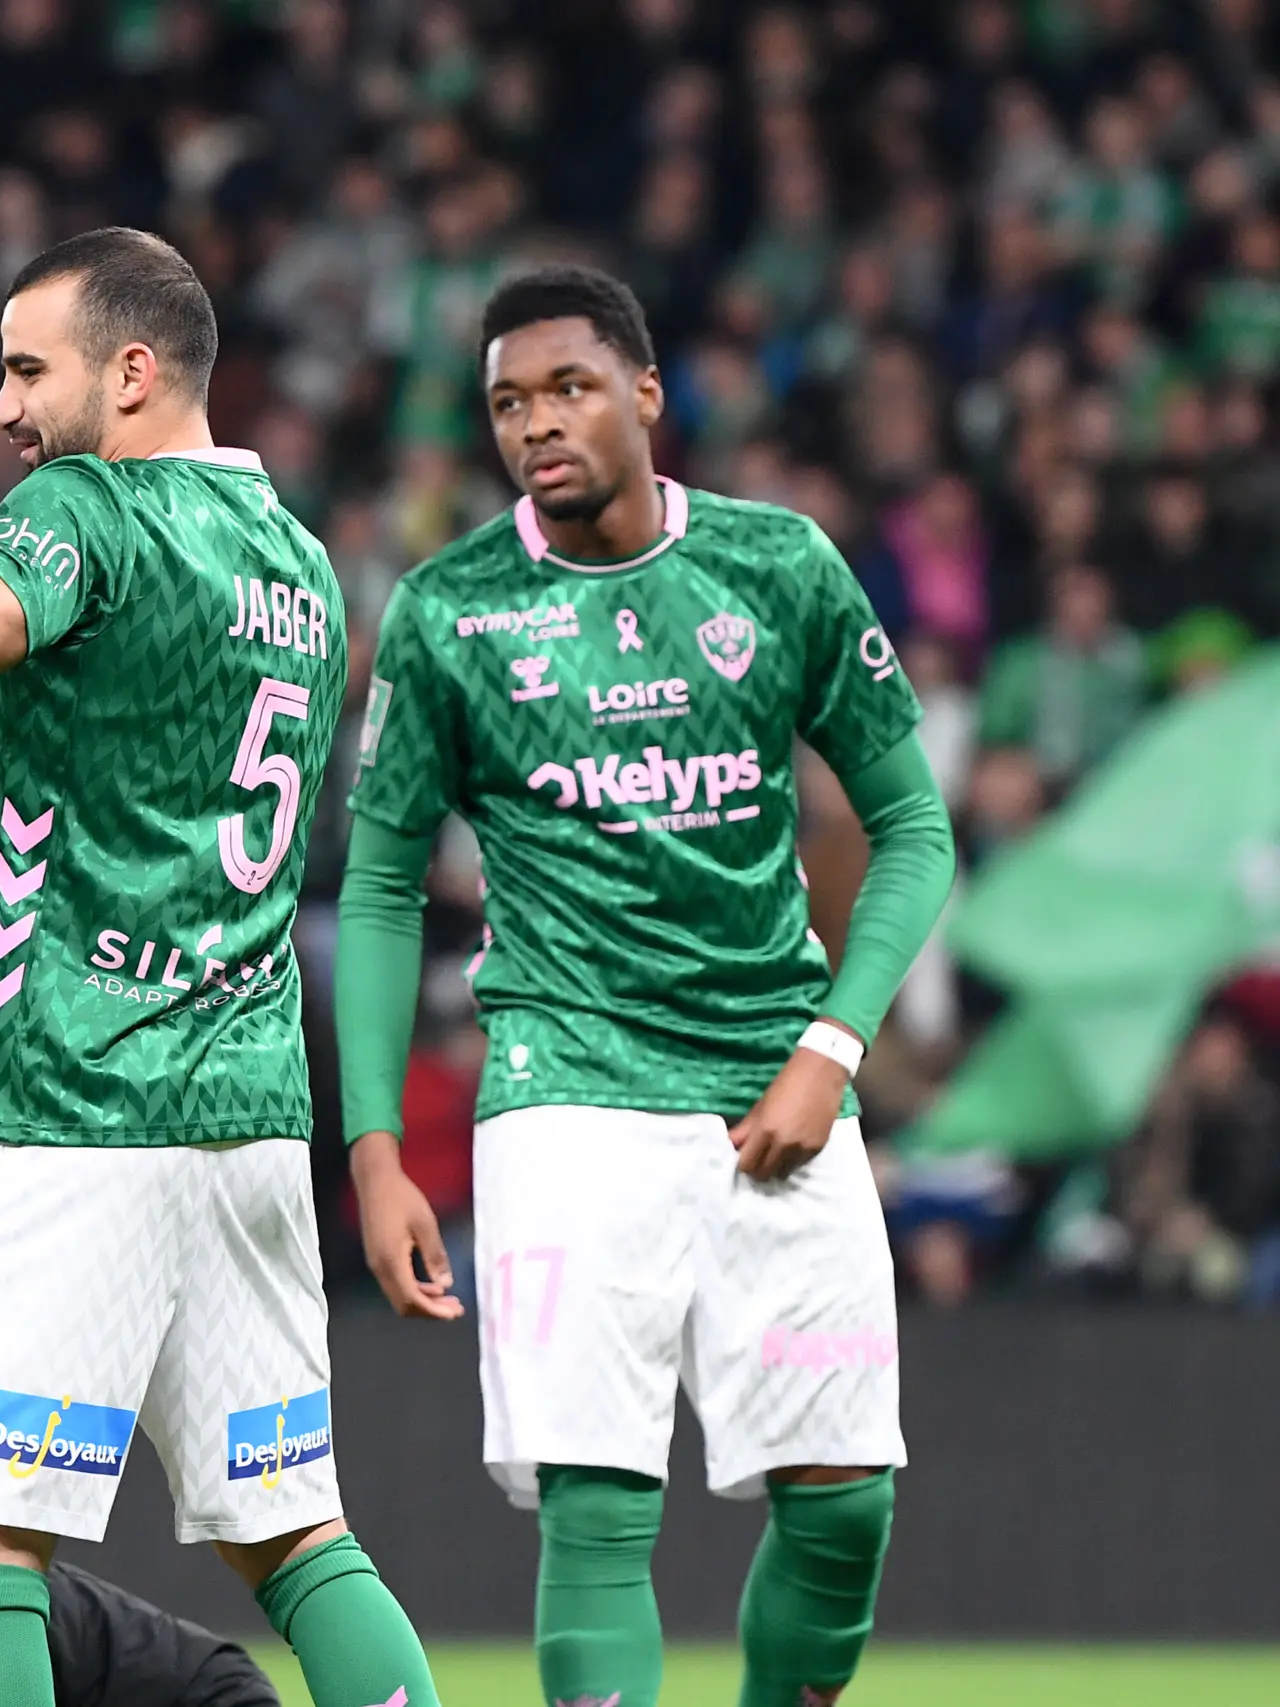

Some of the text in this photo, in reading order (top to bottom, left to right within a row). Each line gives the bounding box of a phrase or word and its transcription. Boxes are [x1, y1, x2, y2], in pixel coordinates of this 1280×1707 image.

[228, 574, 327, 661] JABER
[216, 676, 310, 895] 5
[574, 745, 762, 813] Kelyps
[495, 1246, 567, 1344] 17
